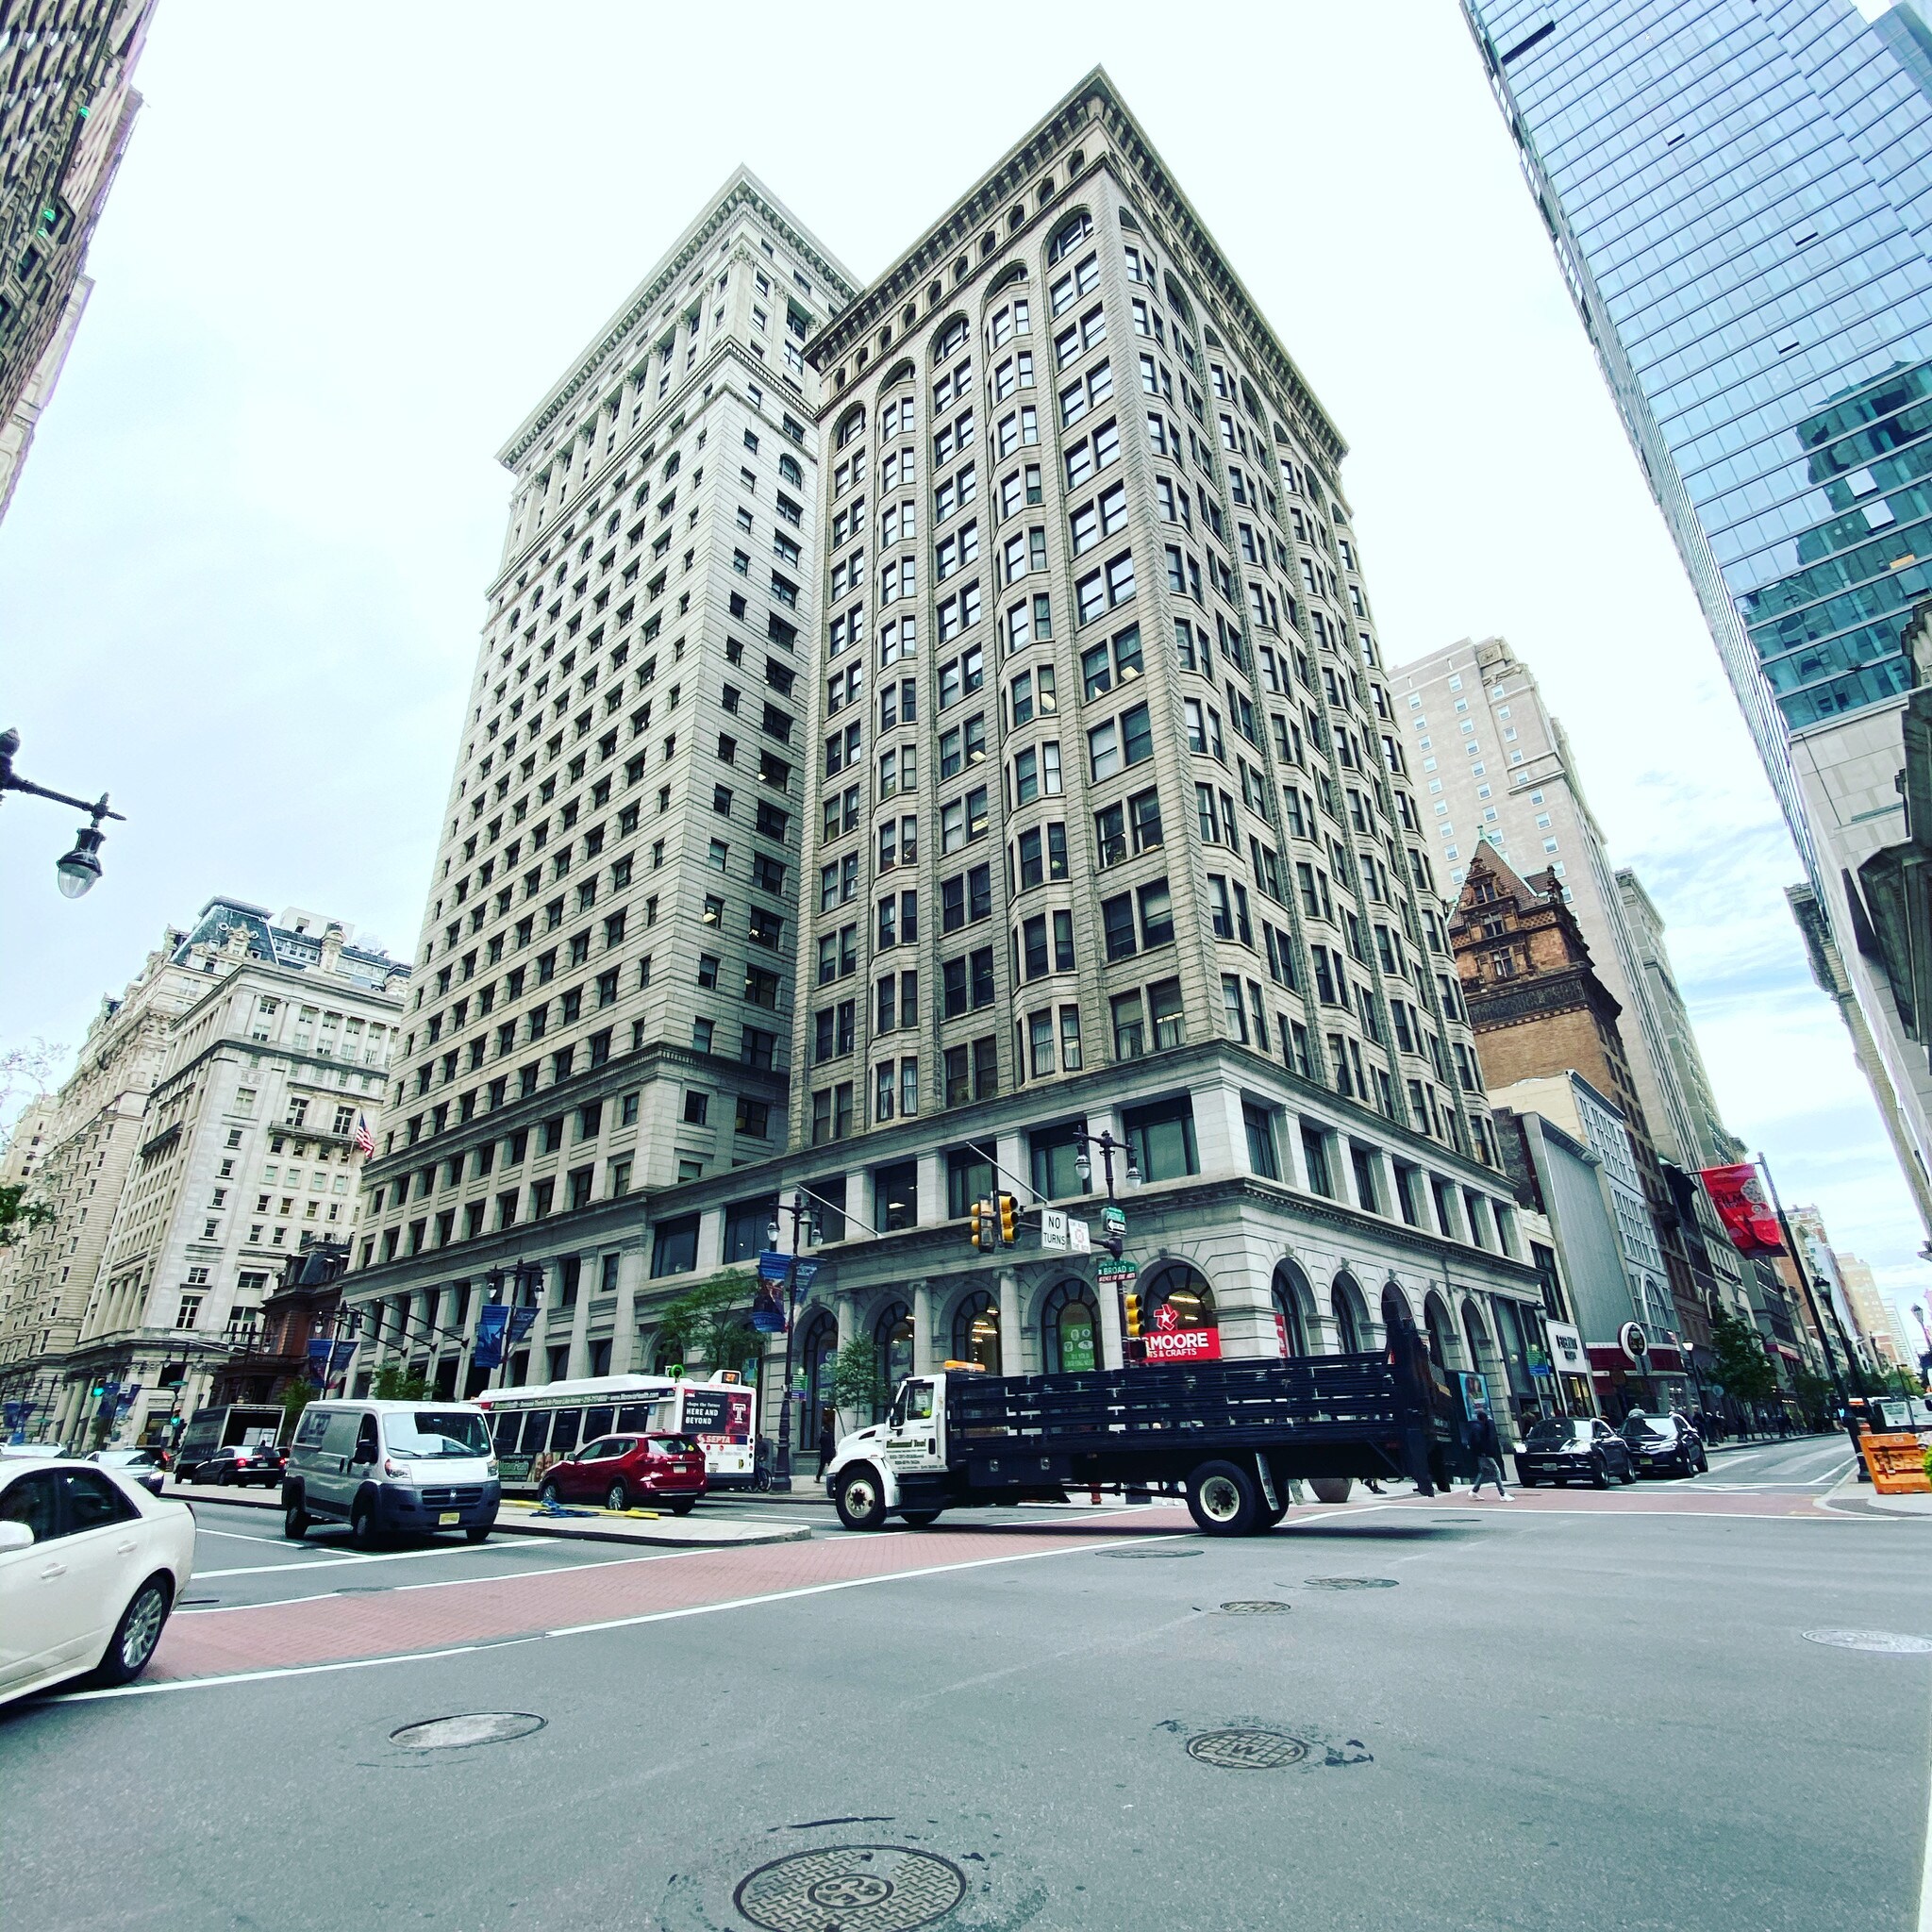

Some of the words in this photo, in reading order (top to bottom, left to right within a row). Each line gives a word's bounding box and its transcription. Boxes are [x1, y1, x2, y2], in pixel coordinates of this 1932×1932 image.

[1048, 1216, 1061, 1229] NO
[1043, 1232, 1066, 1245] TURNS
[1104, 1265, 1127, 1275] BROAD
[1151, 1332, 1209, 1351] MOORE
[1165, 1348, 1197, 1357] CRAFTS
[706, 1435, 731, 1443] SEPTA
